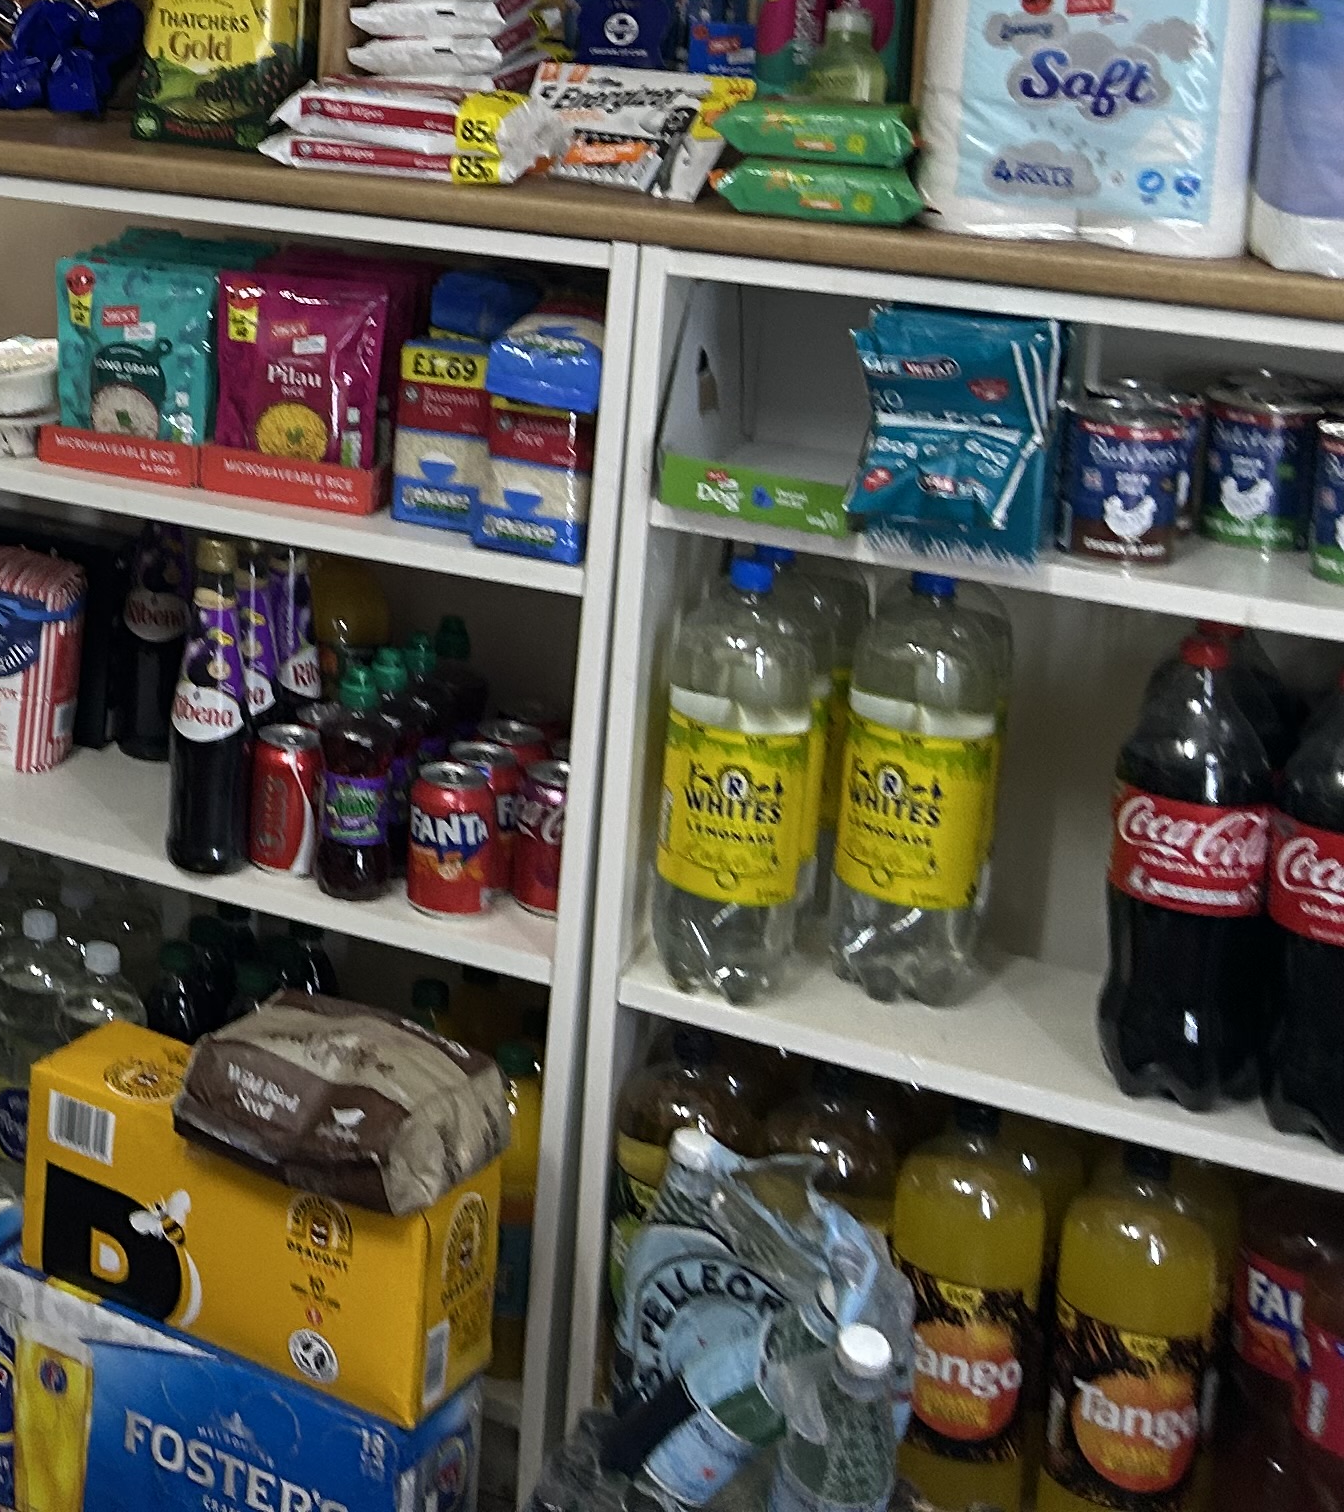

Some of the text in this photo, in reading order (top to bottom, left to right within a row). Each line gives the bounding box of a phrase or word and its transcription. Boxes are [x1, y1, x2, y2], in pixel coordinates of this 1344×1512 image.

[159, 7, 251, 33] THATCHERS
[169, 30, 233, 65] Gold
[1020, 49, 1154, 119] Soft
[267, 364, 322, 388] Pilau
[413, 354, 478, 382] £1.69
[727, 774, 744, 797] R
[882, 772, 899, 795] R
[685, 786, 782, 824] WHITES
[851, 785, 941, 828] WHITES
[413, 806, 488, 847] FANTA
[914, 1331, 1022, 1400] ango
[1073, 1376, 1202, 1452] Tango
